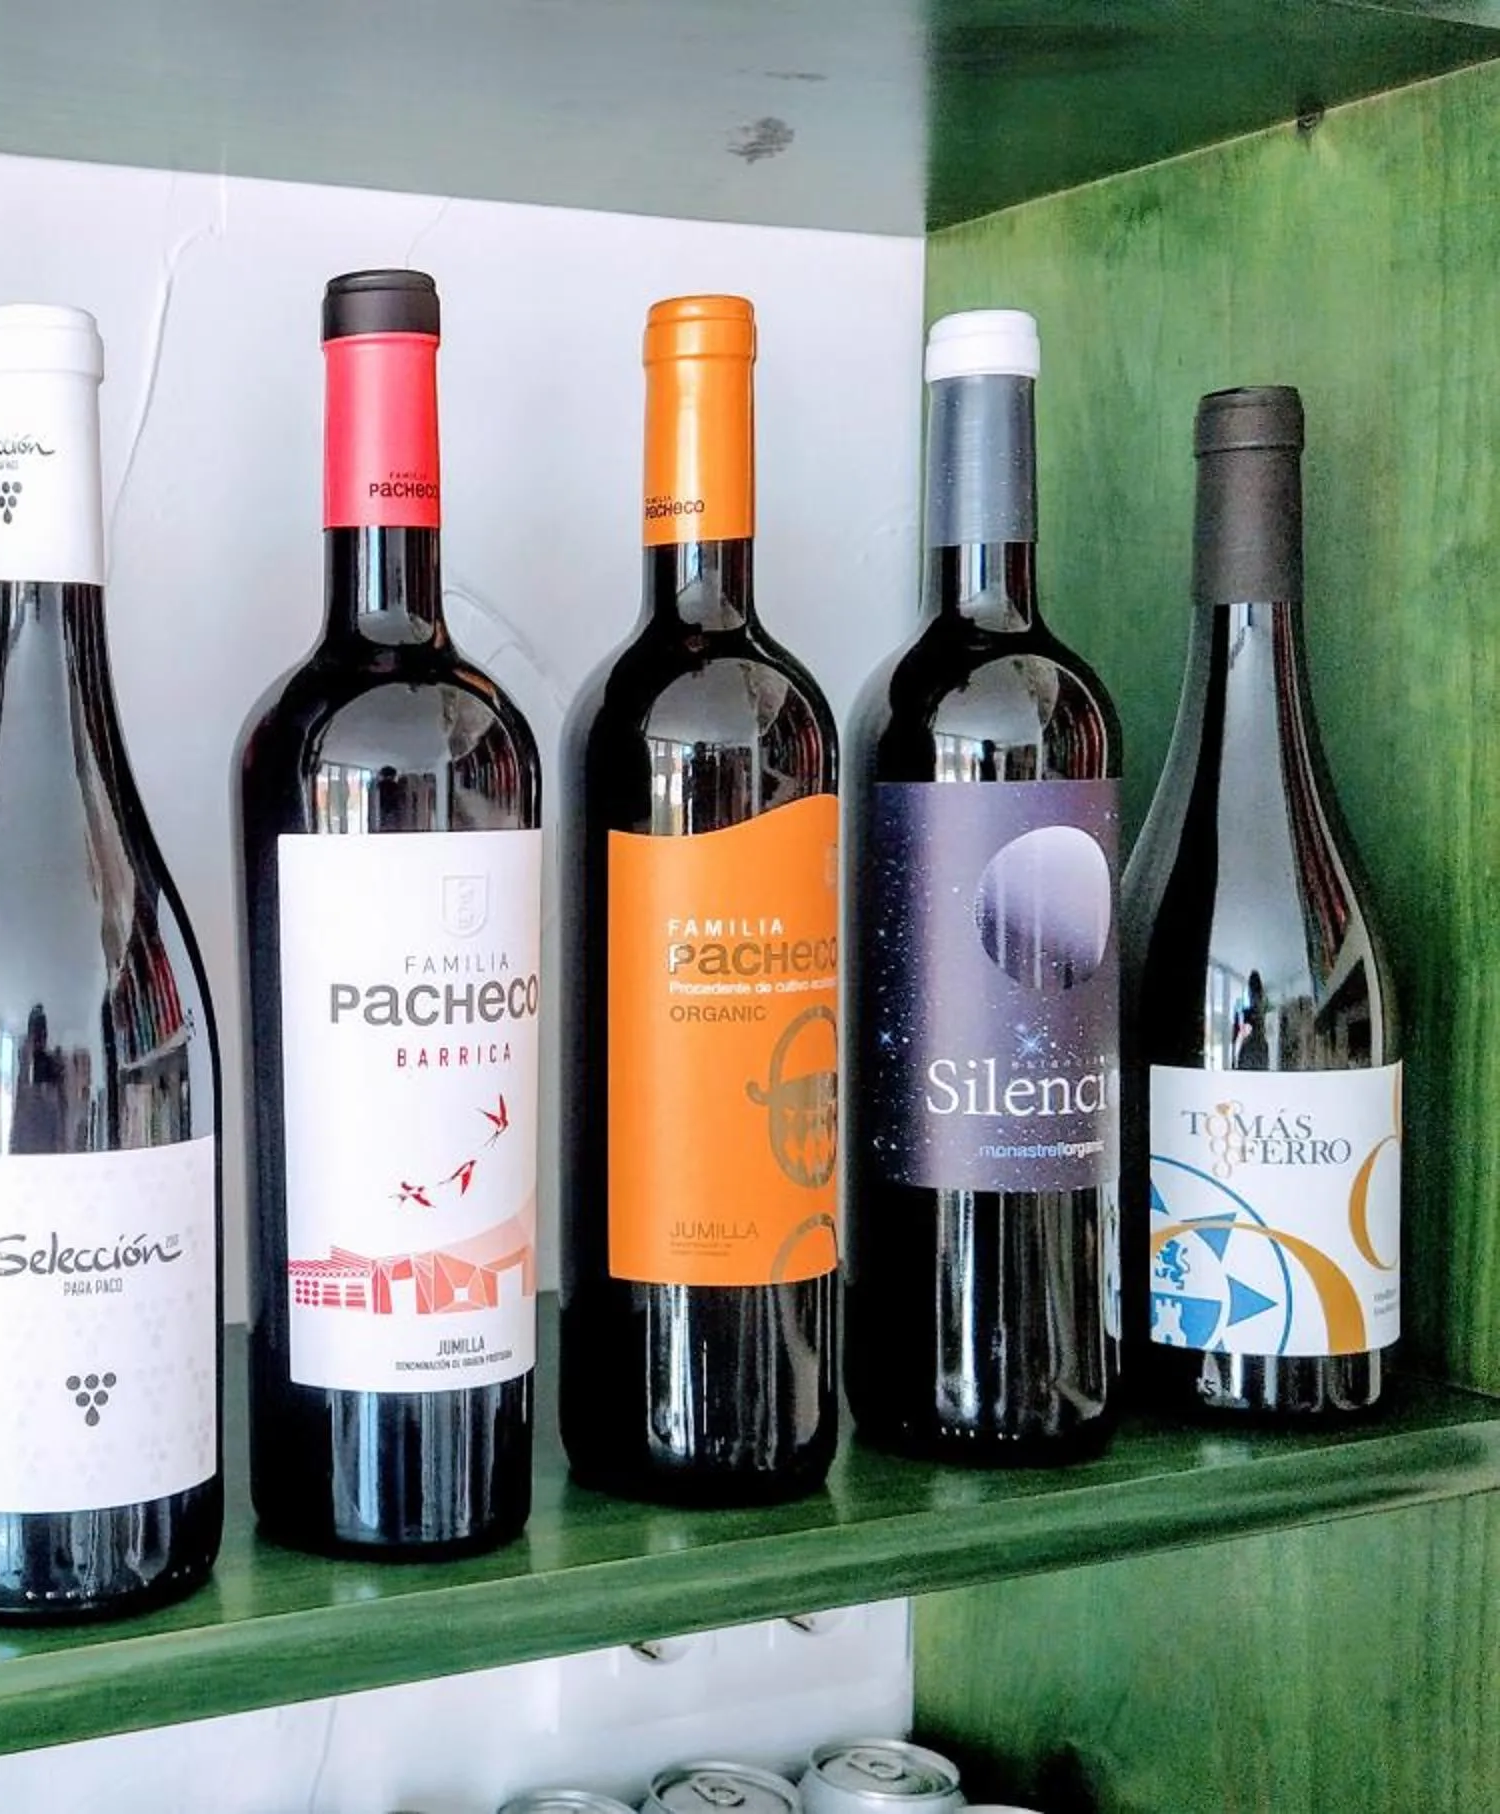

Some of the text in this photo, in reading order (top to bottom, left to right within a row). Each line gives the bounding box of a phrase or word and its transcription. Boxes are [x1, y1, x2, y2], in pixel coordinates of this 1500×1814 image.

[668, 919, 784, 937] FAMILIA
[405, 951, 509, 974] FAMILIA
[669, 1005, 768, 1023] ORGANIC
[397, 1043, 511, 1068] BARRICA
[1238, 1138, 1352, 1165] FERRO
[669, 1220, 760, 1240] JUMILLA
[436, 1335, 485, 1357] JUMILLA
